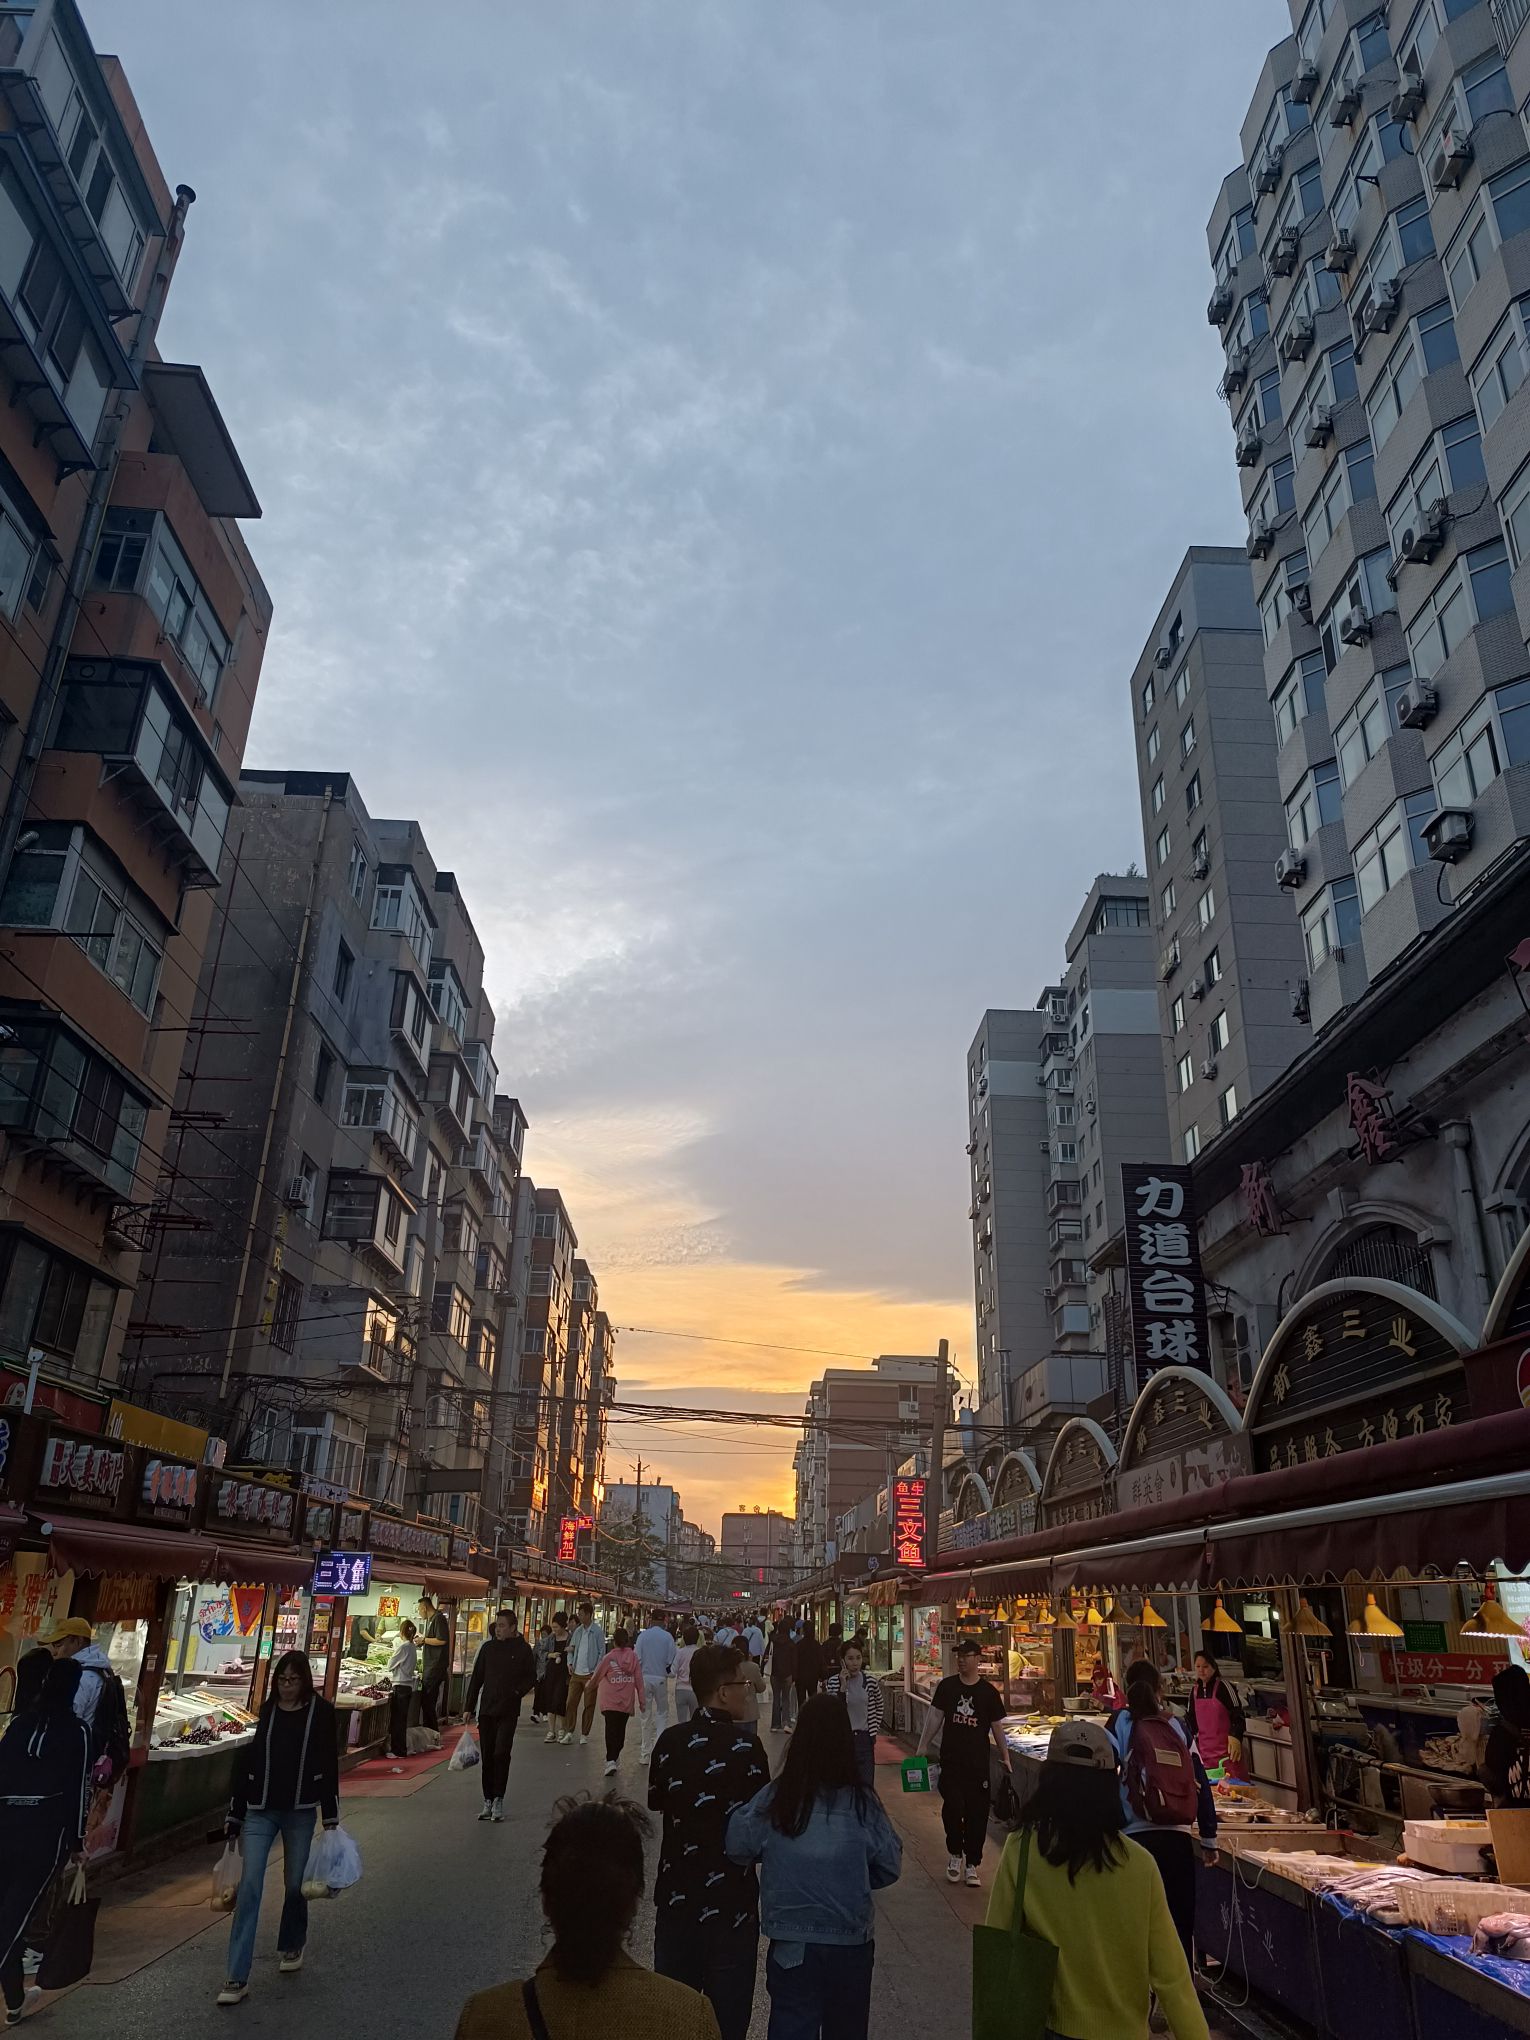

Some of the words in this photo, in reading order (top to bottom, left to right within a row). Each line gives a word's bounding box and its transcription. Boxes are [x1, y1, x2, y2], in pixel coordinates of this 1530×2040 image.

[1135, 1177, 1200, 1381] 力道台球
[1272, 1309, 1417, 1405] 新鑫三业
[1137, 1390, 1214, 1456] 新鑫三业
[896, 1482, 924, 1496] 鱼生
[561, 1521, 575, 1560] 海鲜加工
[897, 1498, 924, 1563] 三文鱼
[1388, 1657, 1484, 1681] 垃圾分一分
